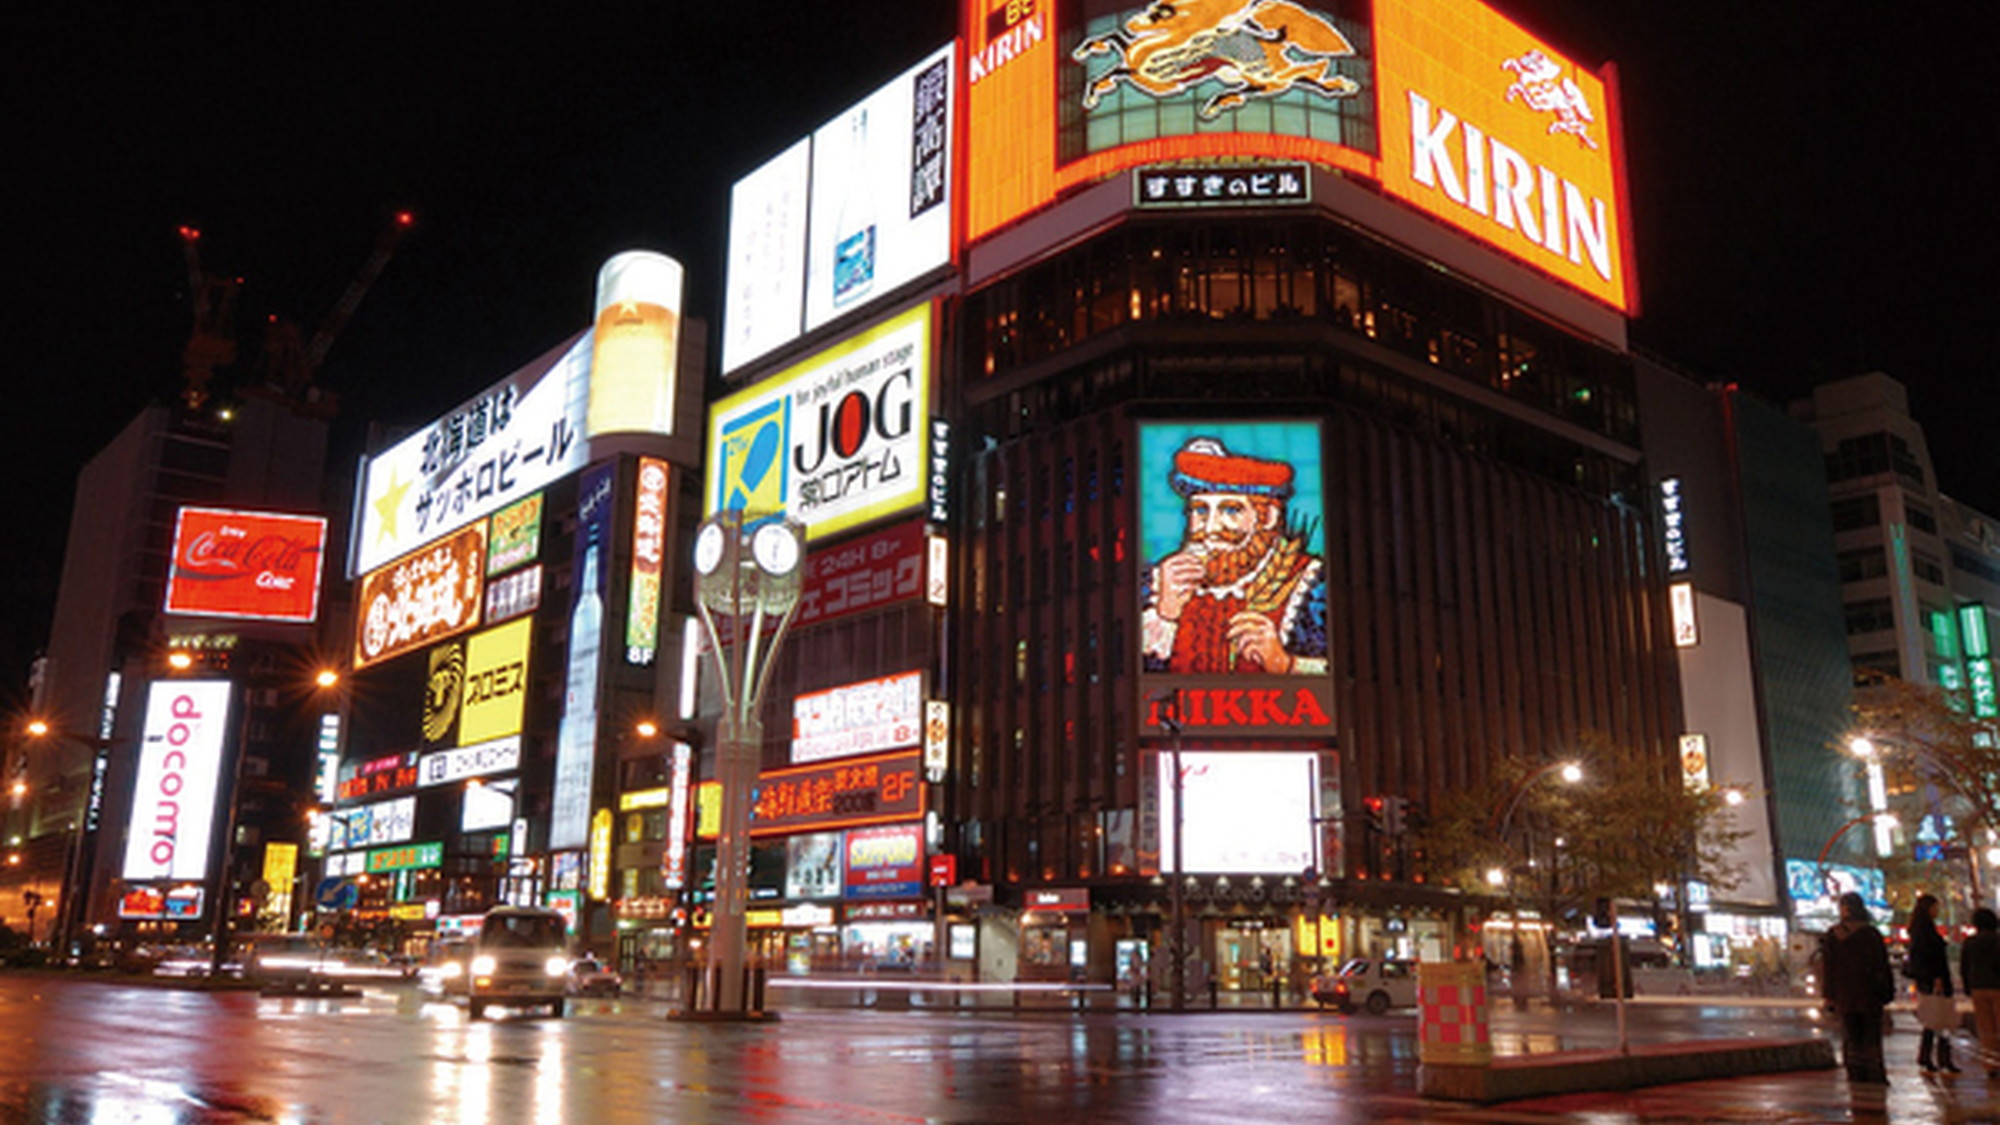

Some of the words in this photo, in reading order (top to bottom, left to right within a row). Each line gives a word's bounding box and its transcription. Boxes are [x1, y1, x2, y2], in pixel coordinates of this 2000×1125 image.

[969, 13, 1044, 83] KIRIN
[1145, 172, 1301, 199] すすきのビル
[1406, 88, 1612, 282] KIRIN
[418, 385, 515, 477] 北海道は
[793, 368, 913, 476] JOG
[415, 417, 575, 534] サッポロビール
[799, 448, 902, 512] 常口アトム
[790, 555, 922, 623] ェコミック
[627, 646, 655, 664] 8F
[150, 695, 202, 865] docomo
[882, 770, 915, 802] 2F
